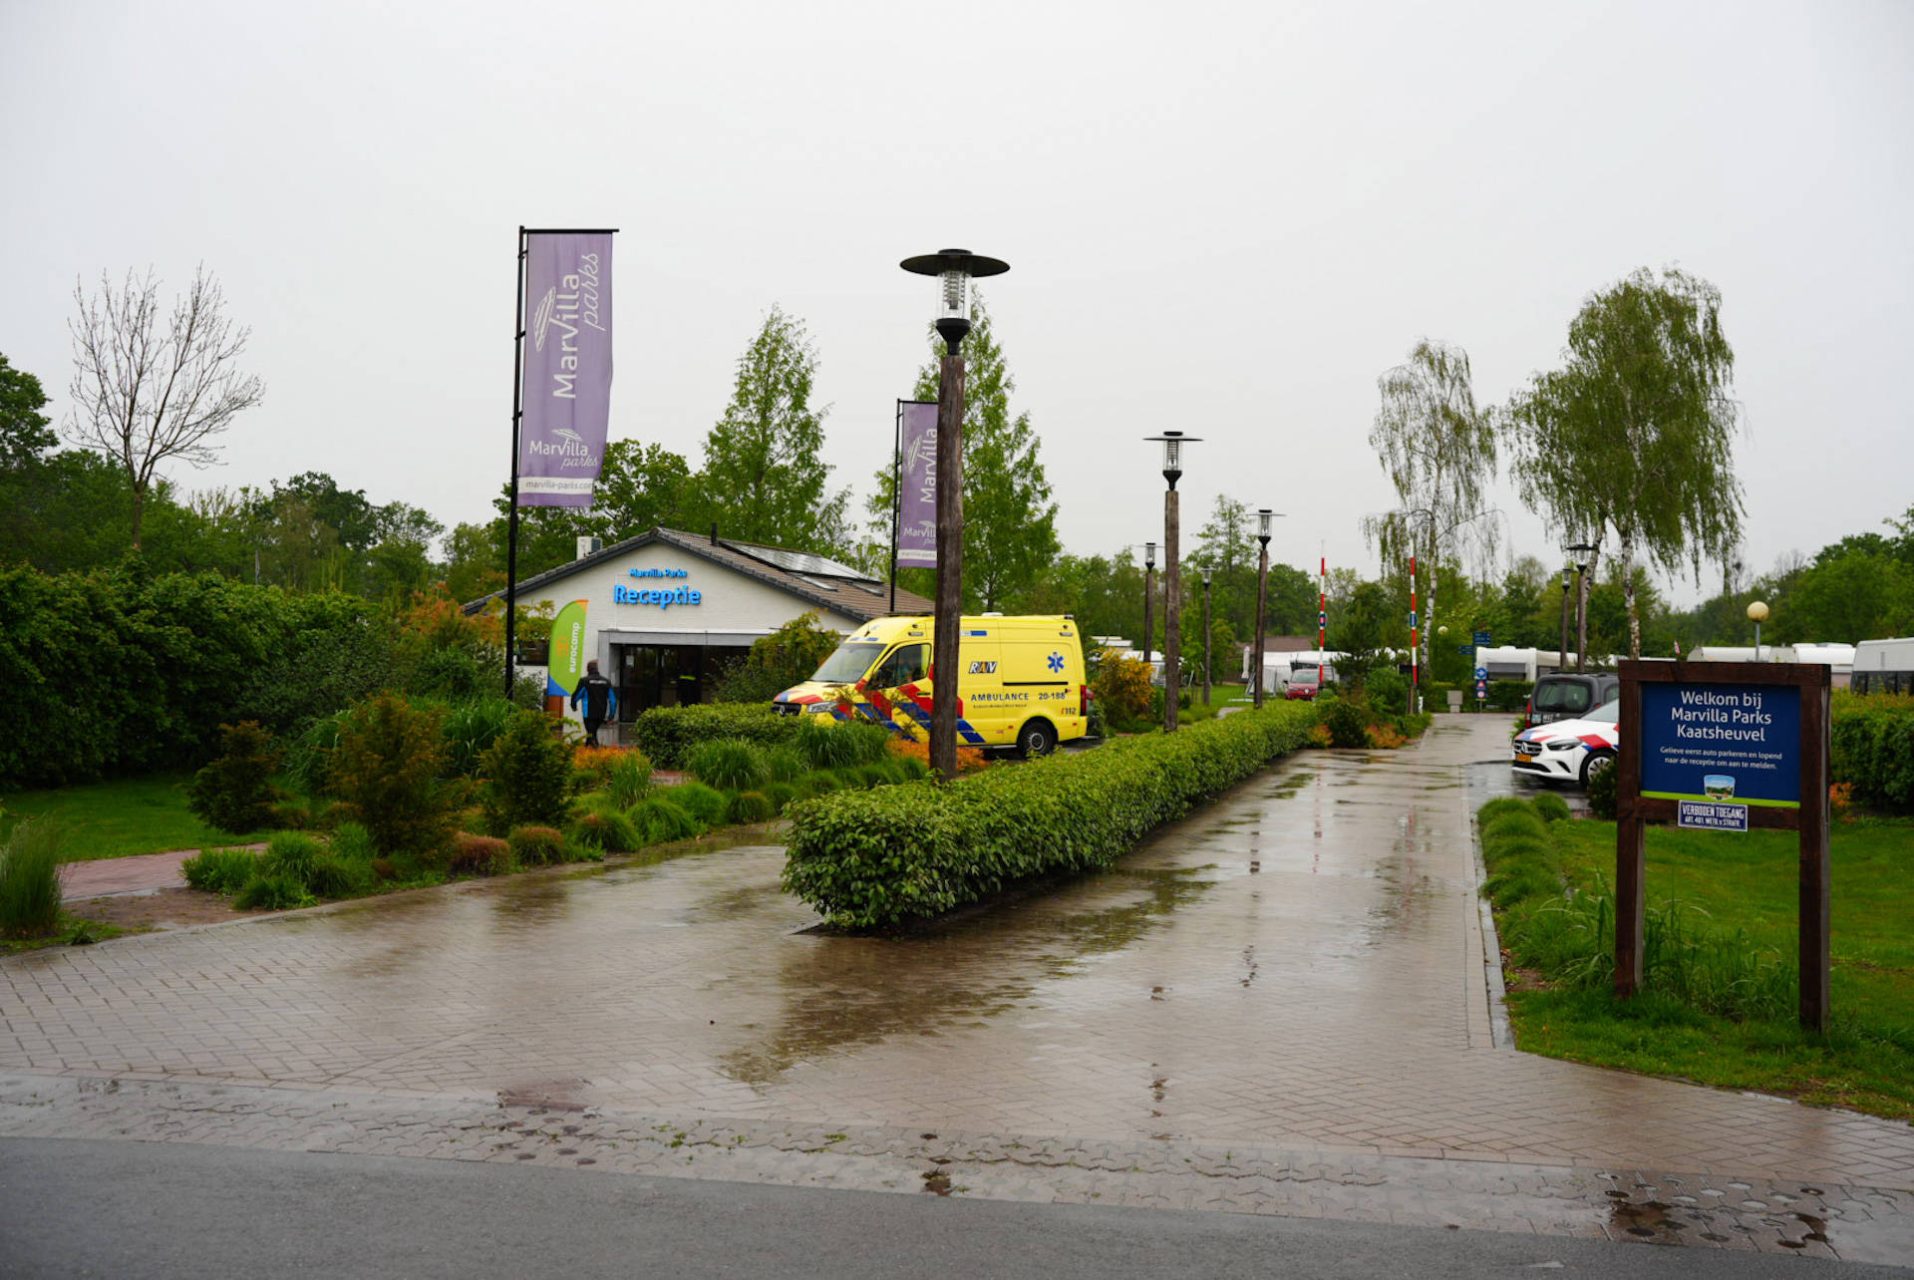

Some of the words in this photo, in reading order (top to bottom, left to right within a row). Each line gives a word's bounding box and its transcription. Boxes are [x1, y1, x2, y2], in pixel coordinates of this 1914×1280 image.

[578, 252, 606, 332] parks
[614, 584, 702, 609] Receptie
[570, 622, 583, 673] eurocamp
[968, 661, 998, 674] RAV
[971, 692, 1029, 701] AMBULANCE
[1681, 691, 1739, 706] Welkom
[1743, 692, 1762, 709] bij
[1671, 707, 1729, 723] Marvilla
[1732, 709, 1772, 725] Parks
[1677, 724, 1766, 741] Kaatsheuvel
[1660, 746, 1684, 755] Gelieve
[1685, 748, 1702, 756] eerst
[1718, 749, 1747, 758] parkeren
[1758, 751, 1783, 760] lopend
[1689, 757, 1715, 767] receptie
[1682, 804, 1715, 817] VERBODEN
[1716, 807, 1745, 819] TOEGANG
